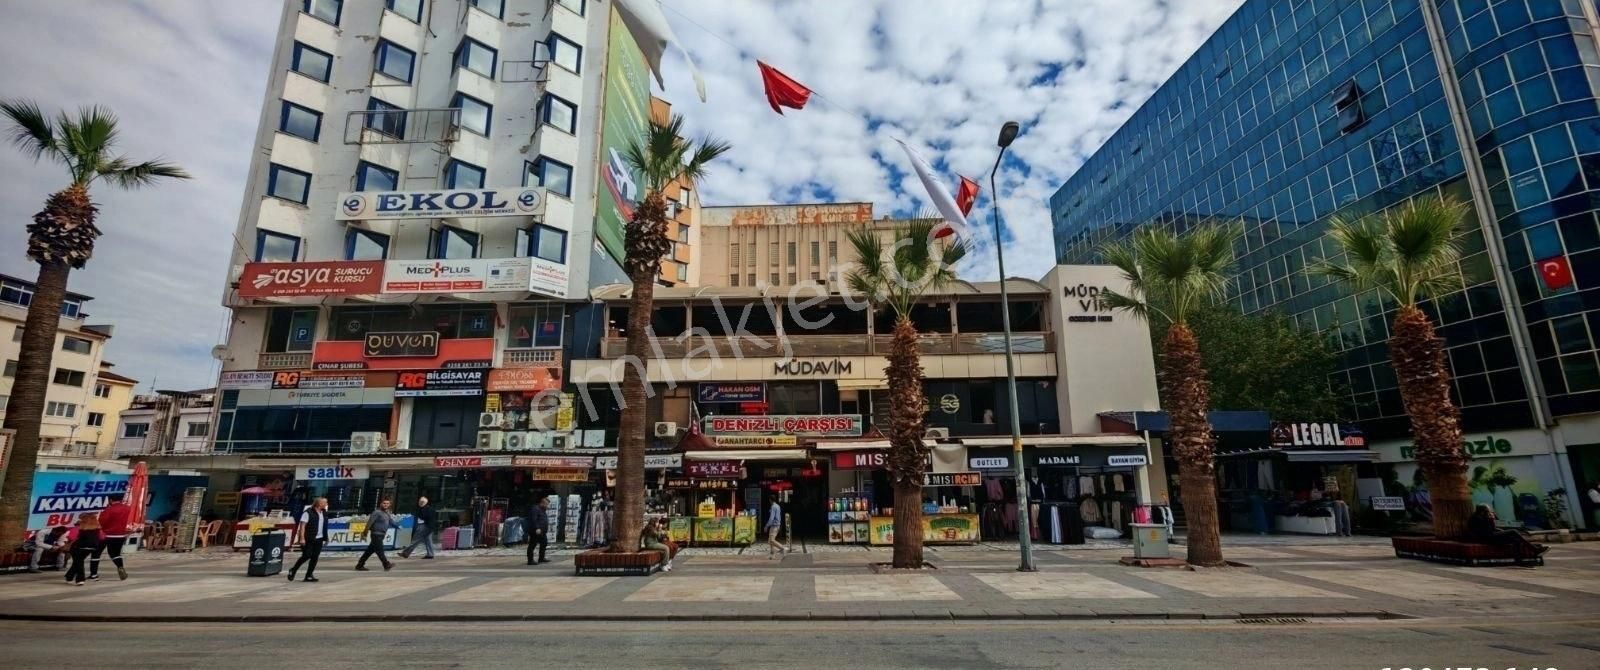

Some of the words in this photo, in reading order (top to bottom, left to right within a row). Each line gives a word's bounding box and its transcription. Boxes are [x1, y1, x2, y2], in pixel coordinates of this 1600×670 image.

[376, 192, 509, 211] EKOL
[275, 268, 331, 287] asya
[334, 275, 366, 283] KURSU
[774, 359, 852, 376] MÜDAVİM
[401, 373, 424, 387] RG
[426, 370, 482, 380] BİLGİSAYAR
[784, 416, 854, 433] ÇARŞISI
[724, 437, 765, 445] ANAHTARCI
[1291, 422, 1345, 446] LEGAL
[1038, 456, 1080, 465] MADAME
[308, 465, 353, 479] saatix
[690, 465, 739, 474] TEKEL
[53, 481, 79, 494] BU
[37, 495, 110, 512] KAYNA
[47, 513, 73, 527] BU
